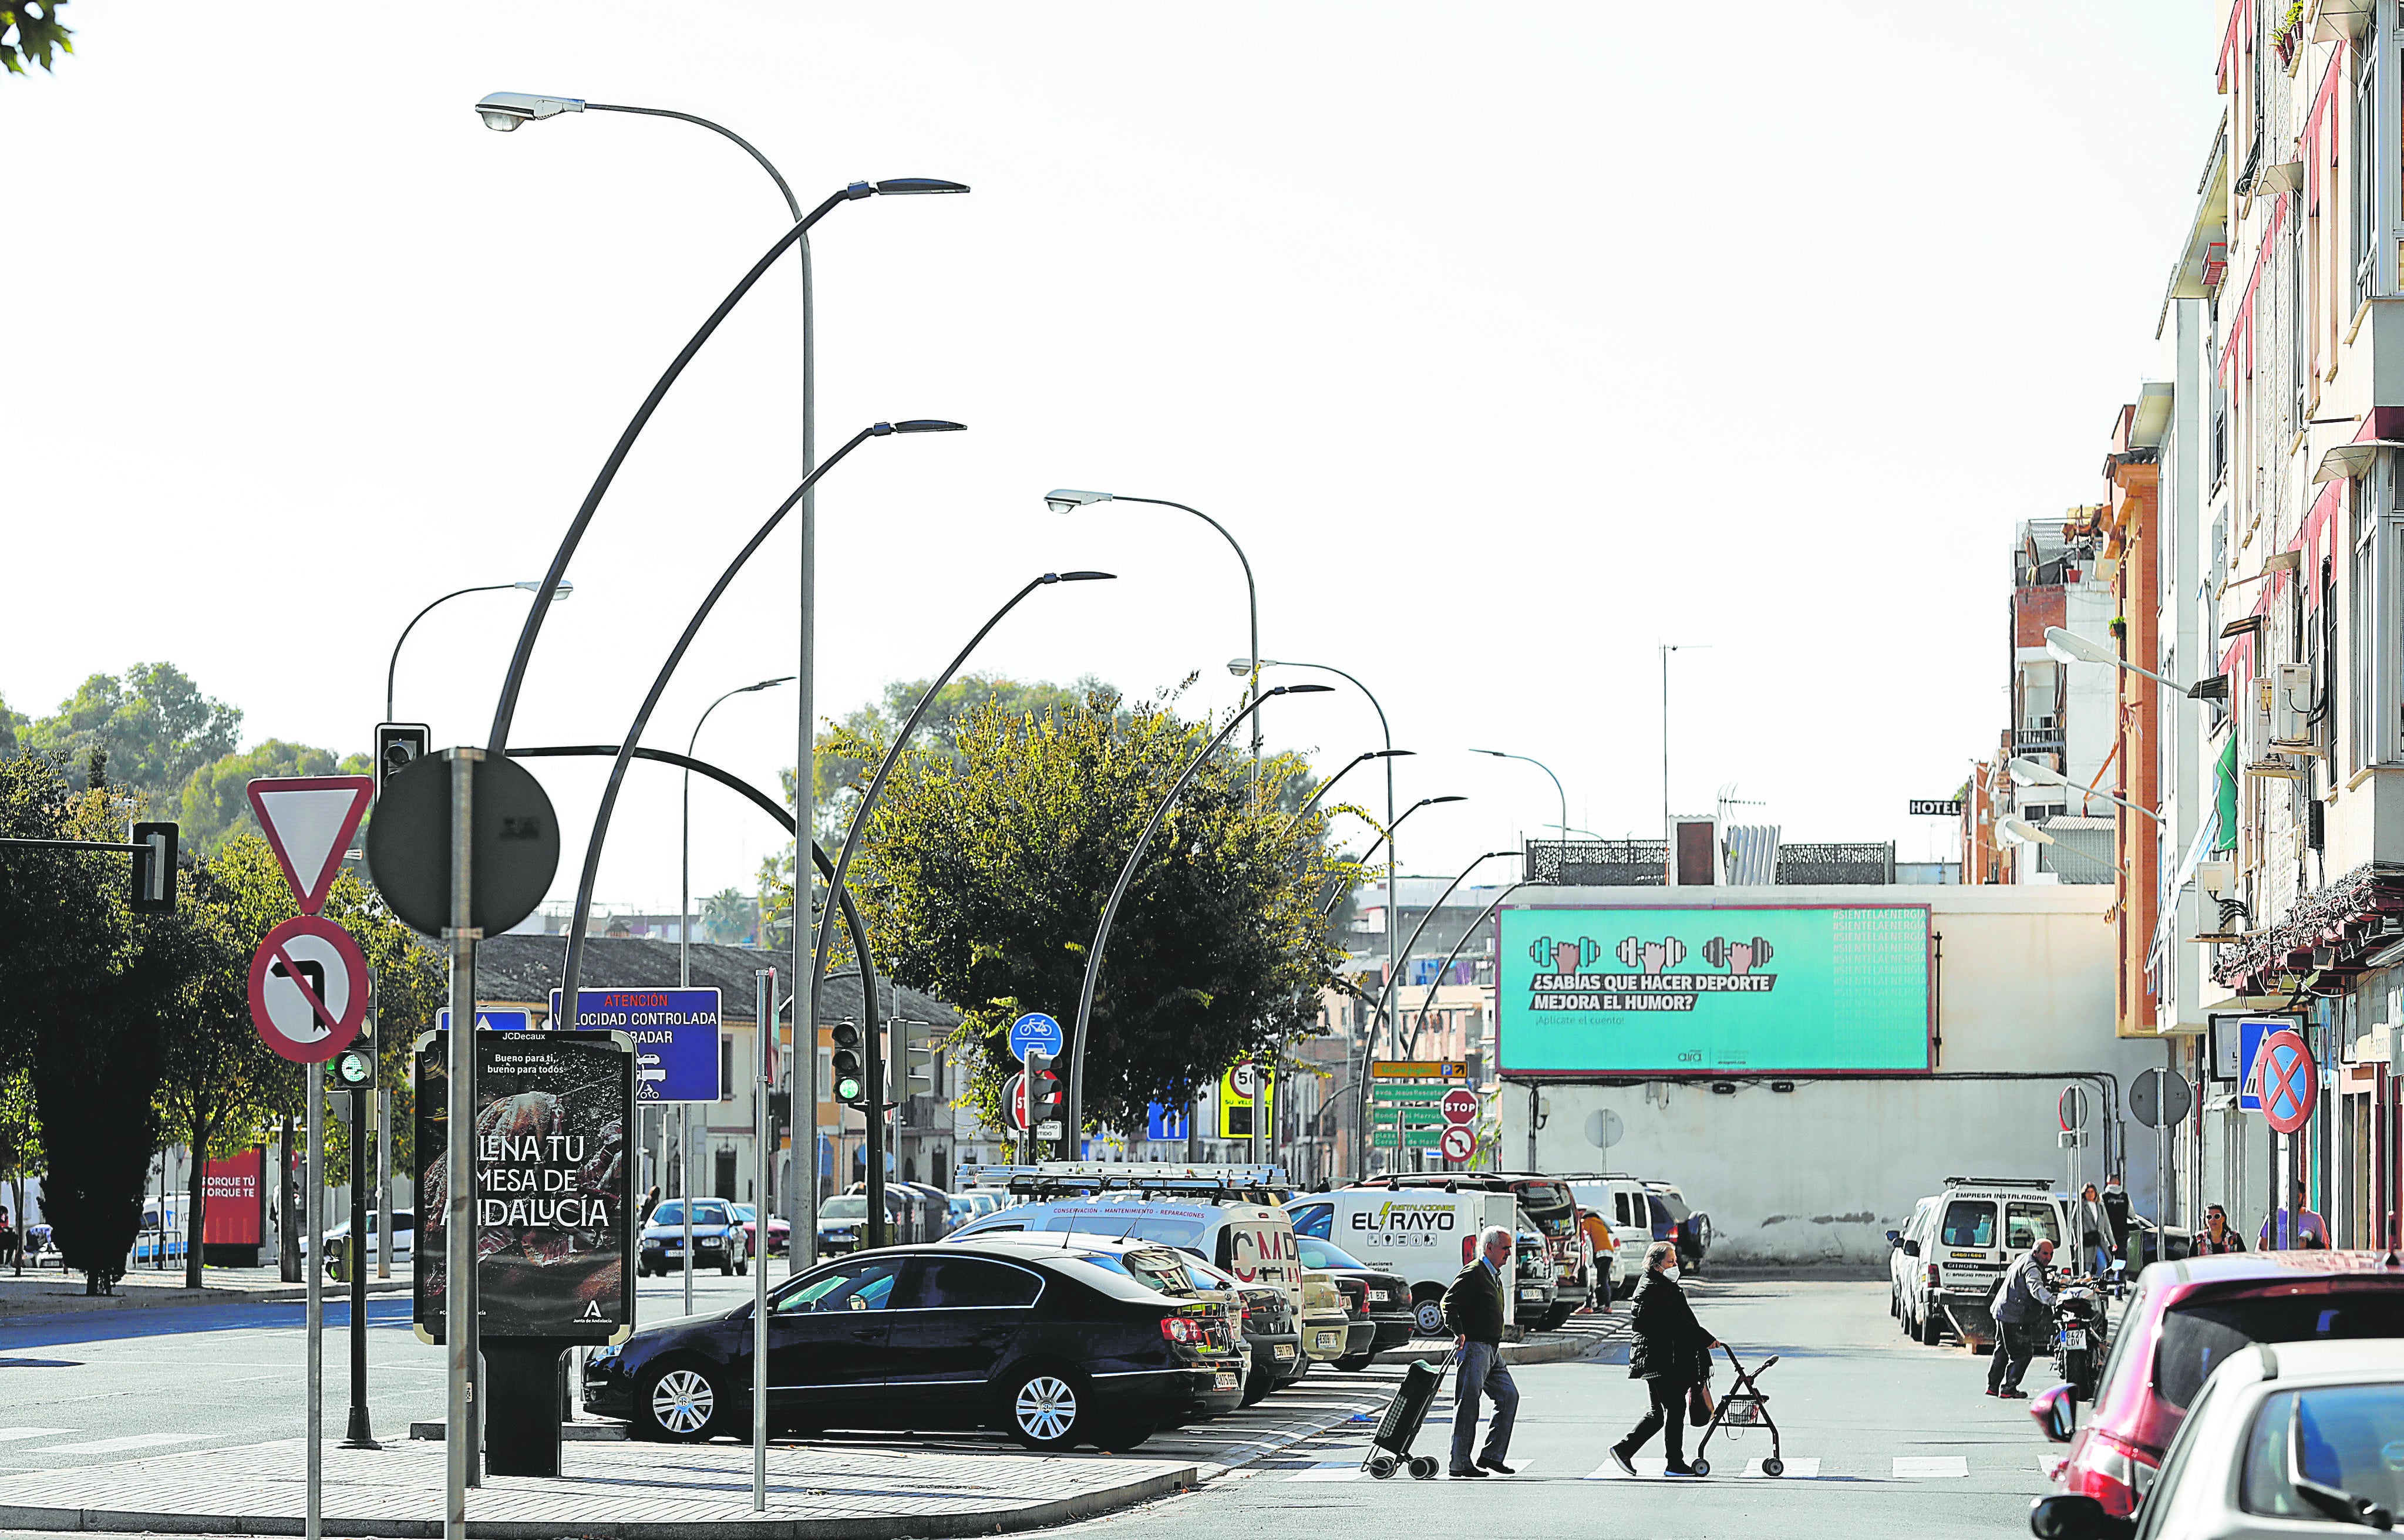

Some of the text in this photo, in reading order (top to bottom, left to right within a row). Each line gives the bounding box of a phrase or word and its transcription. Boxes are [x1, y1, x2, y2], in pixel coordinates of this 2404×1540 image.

[1911, 801, 1960, 814] HOTEL
[1833, 909, 1927, 919] #SIENTELAENERGÍA
[1833, 920, 1927, 931] #SIENTELAENERGÍA
[1833, 931, 1927, 941] #SIENTELAENERGÍA
[1833, 943, 1927, 952] #SIENTELAENERGÍA
[1534, 973, 1769, 992] ¿SABÍAS QUE HACER DEPORTE
[605, 992, 668, 1006] ATENCIÓN
[1534, 995, 1694, 1010] MEJORA EL HUMOR?
[631, 1012, 717, 1025] CONTROLADA
[1590, 1016, 1625, 1025] cuento!
[526, 1055, 545, 1063] para
[547, 1054, 556, 1063] ti,
[487, 1065, 564, 1075] bueno para todos
[1443, 1066, 1450, 1074] P
[1445, 1103, 1476, 1112] STOP
[476, 1135, 584, 1162] LENA TU
[243, 1175, 255, 1186] TÚ
[544, 1170, 577, 1191] DE
[243, 1188, 254, 1197] TE
[1994, 1193, 2047, 1201] INSTALADORA
[1160, 1209, 1204, 1218] REPARACIONES
[1352, 1212, 1454, 1230] EL RAYO
